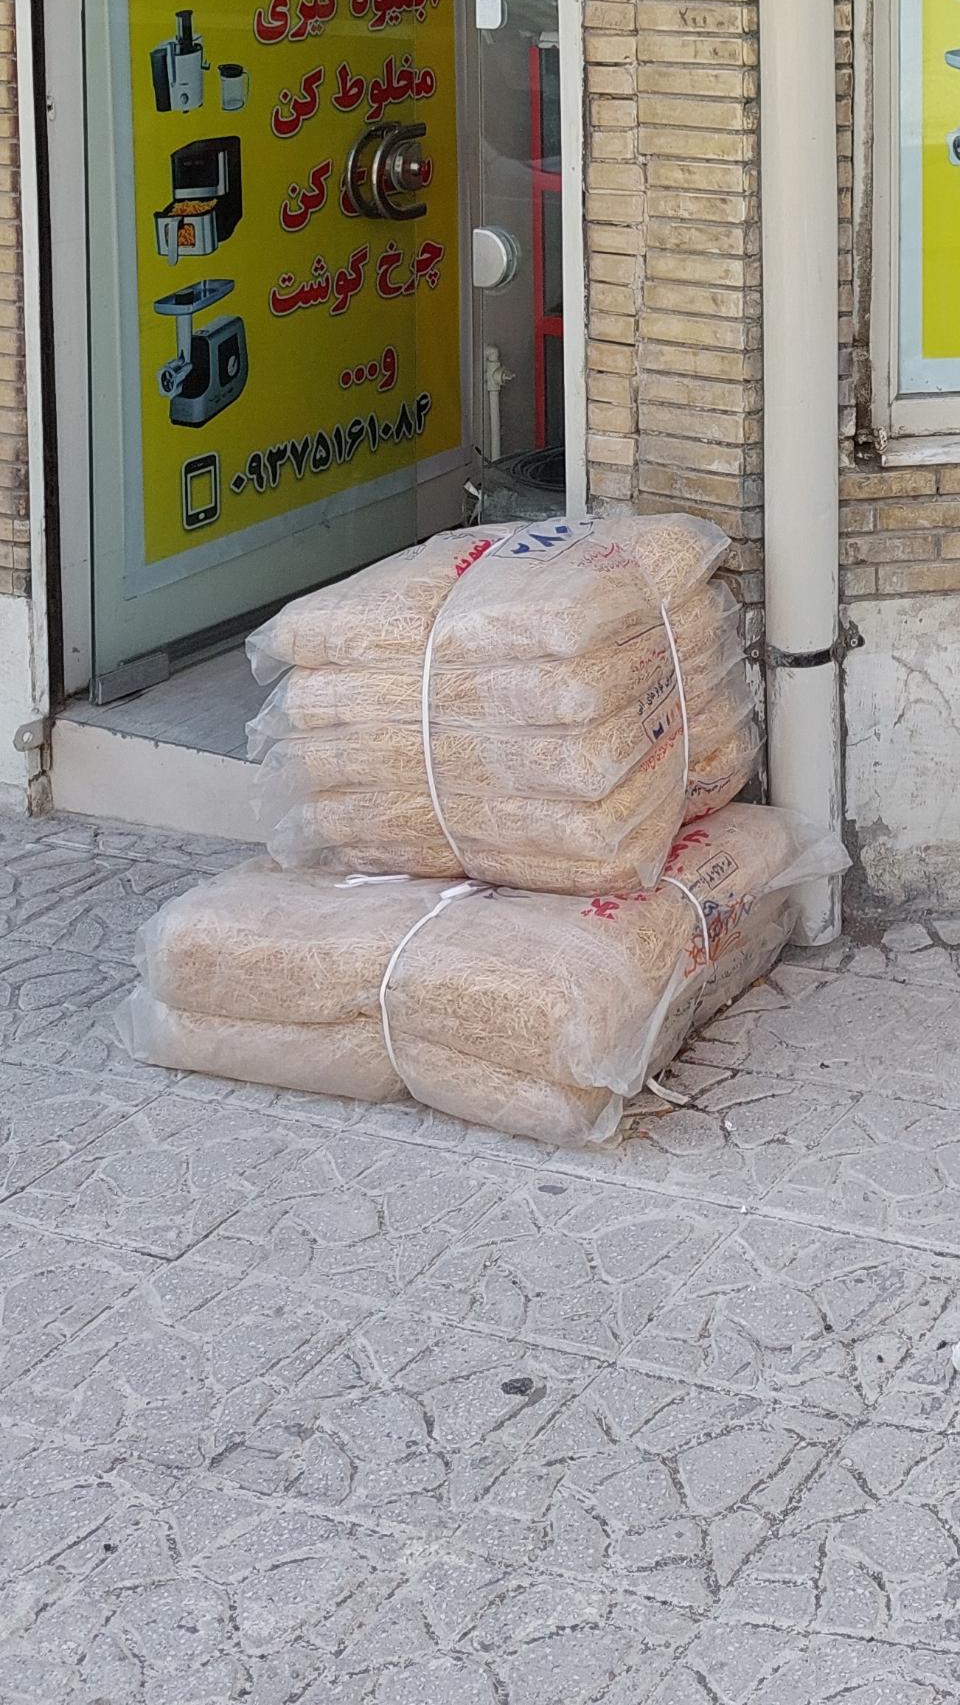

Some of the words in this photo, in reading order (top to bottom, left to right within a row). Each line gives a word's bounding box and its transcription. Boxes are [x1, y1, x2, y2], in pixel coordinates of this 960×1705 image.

[271, 63, 325, 138] کن
[332, 54, 437, 123] مخلوط
[280, 158, 332, 232] کن
[269, 245, 370, 317] گوشت
[230, 391, 432, 493] ۰۹۳۷۵۱۶۱۰۸۴
